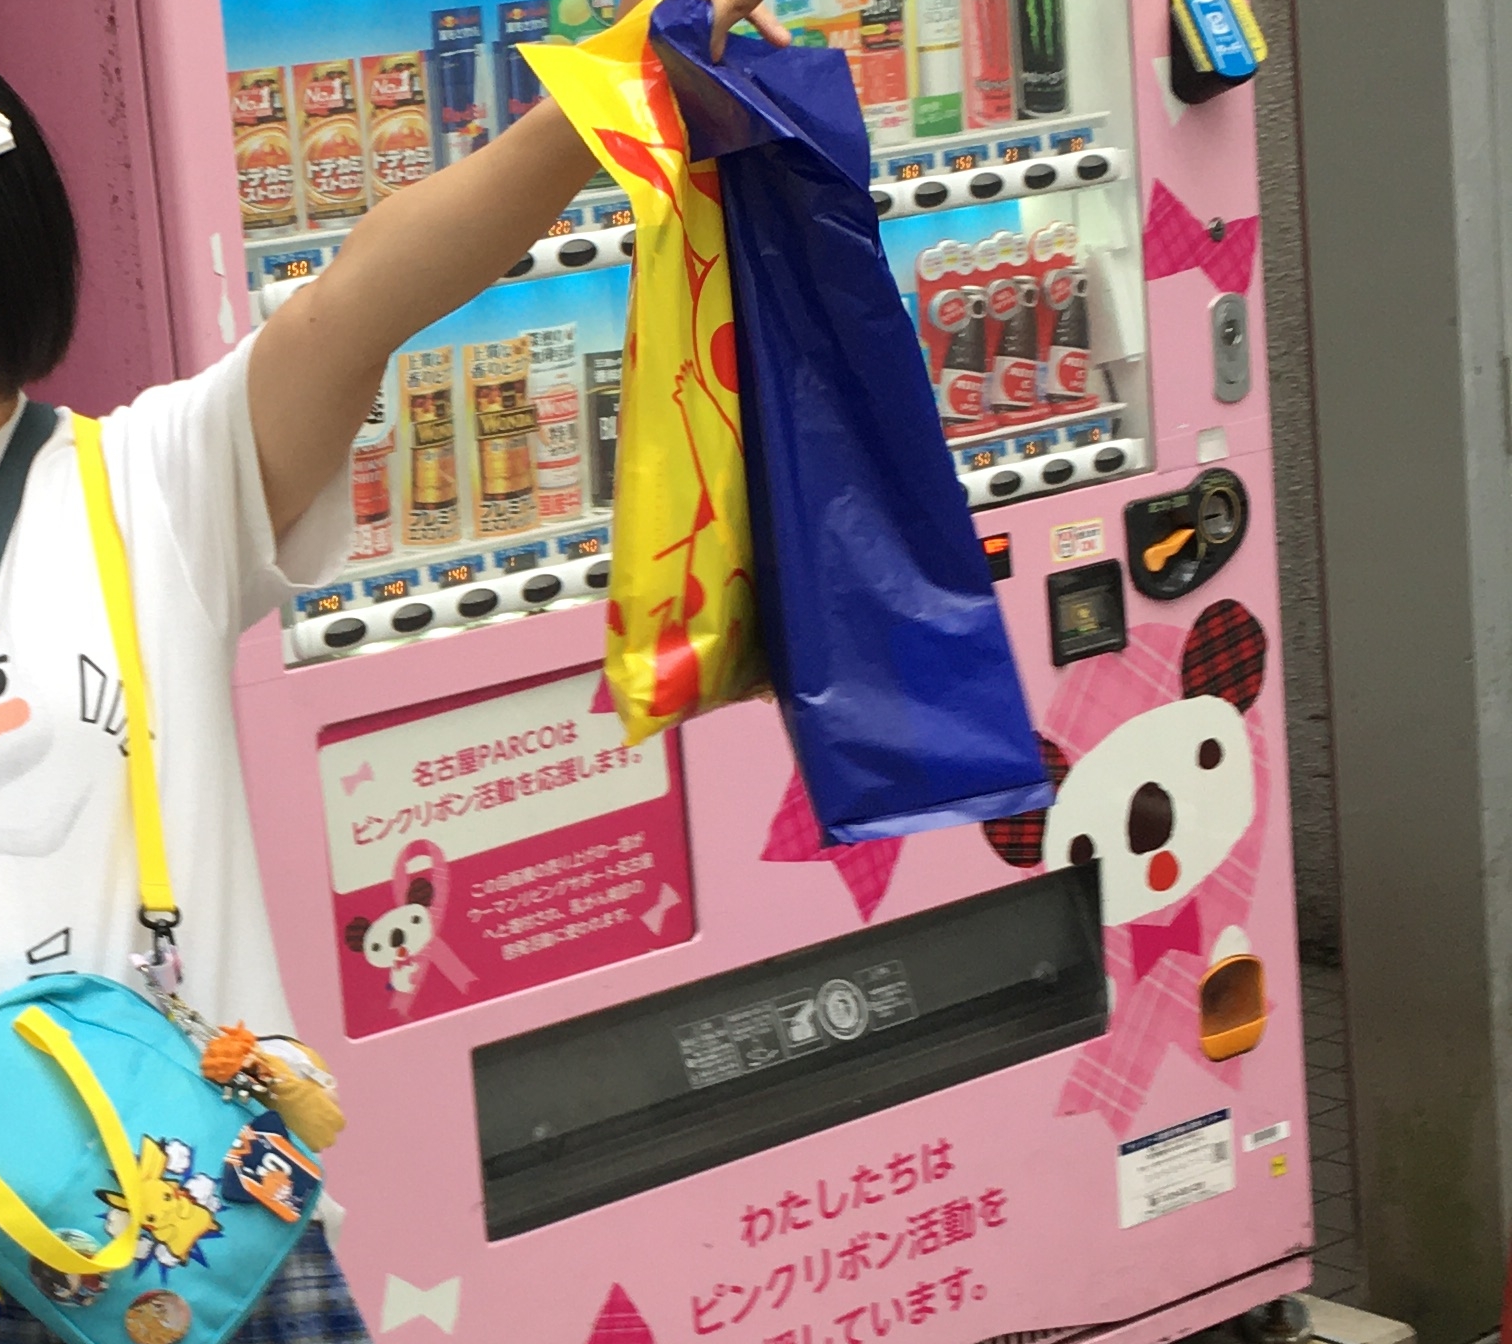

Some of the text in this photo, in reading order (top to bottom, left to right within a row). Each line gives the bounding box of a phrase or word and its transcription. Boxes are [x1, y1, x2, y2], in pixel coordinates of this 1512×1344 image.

[411, 719, 579, 789] 名古屋PARCOは
[738, 1137, 957, 1249] わたしたちは
[690, 1187, 1008, 1337] ピンクリボン活動を
